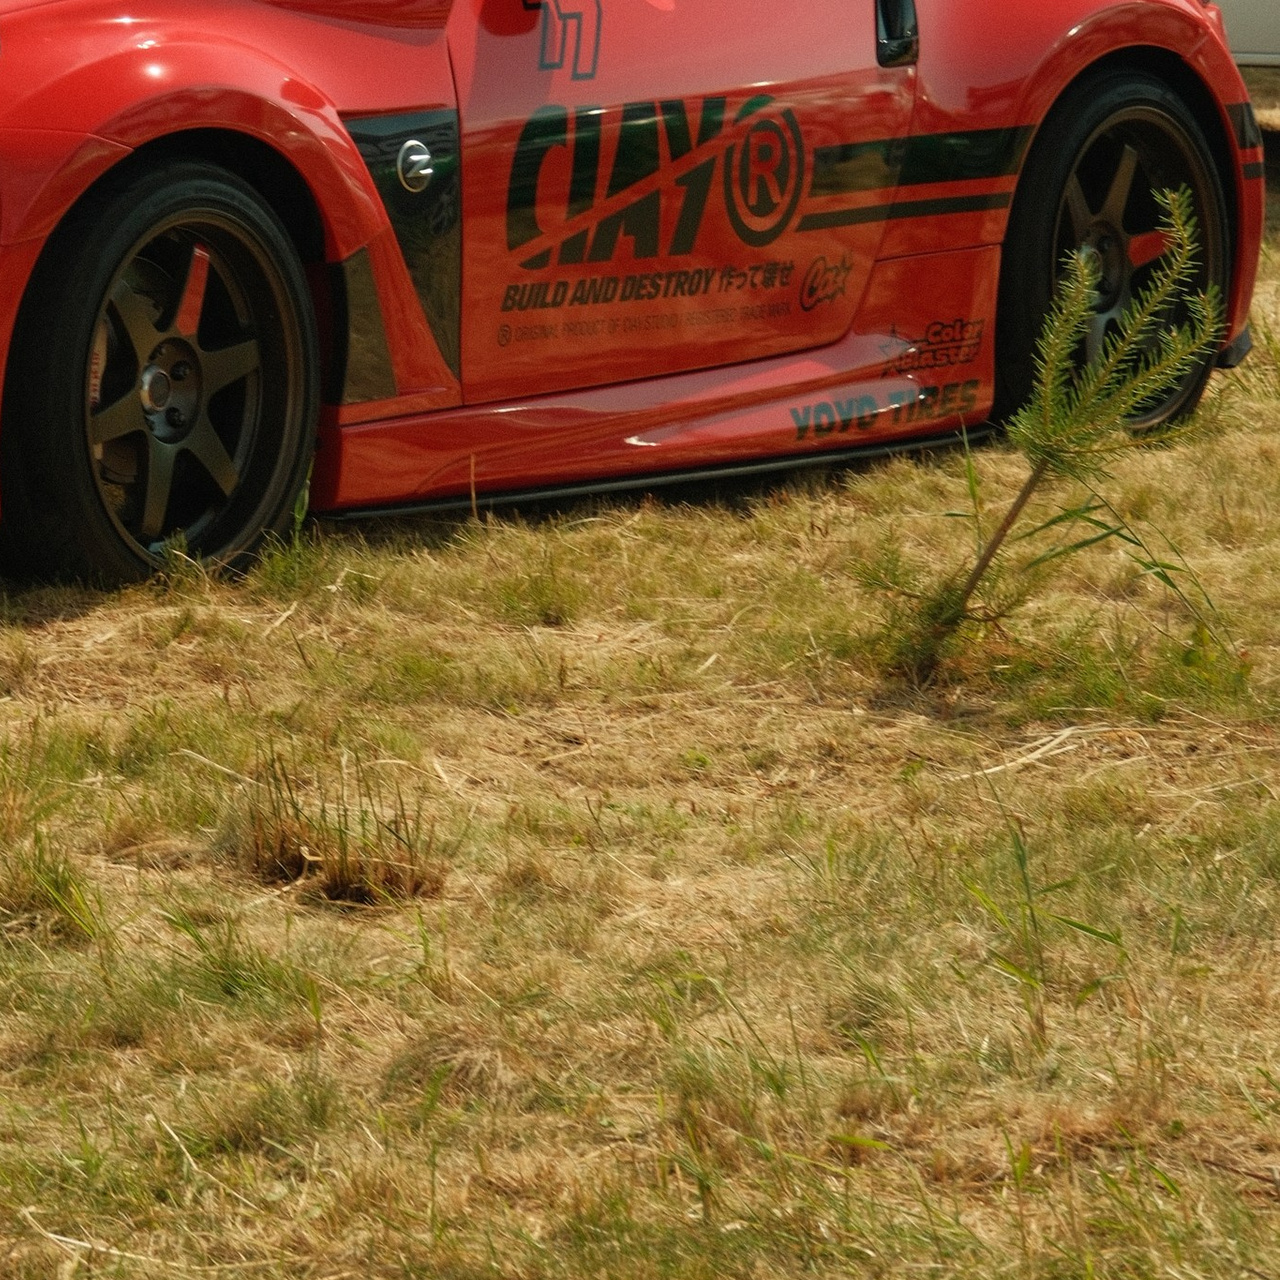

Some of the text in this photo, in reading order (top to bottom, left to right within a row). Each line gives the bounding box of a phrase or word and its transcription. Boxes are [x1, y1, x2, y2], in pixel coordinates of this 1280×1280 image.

[501, 278, 567, 312] BUILD
[569, 274, 620, 306] AND
[620, 267, 717, 303] DESTROY
[788, 379, 980, 441] YOYO TIRES
